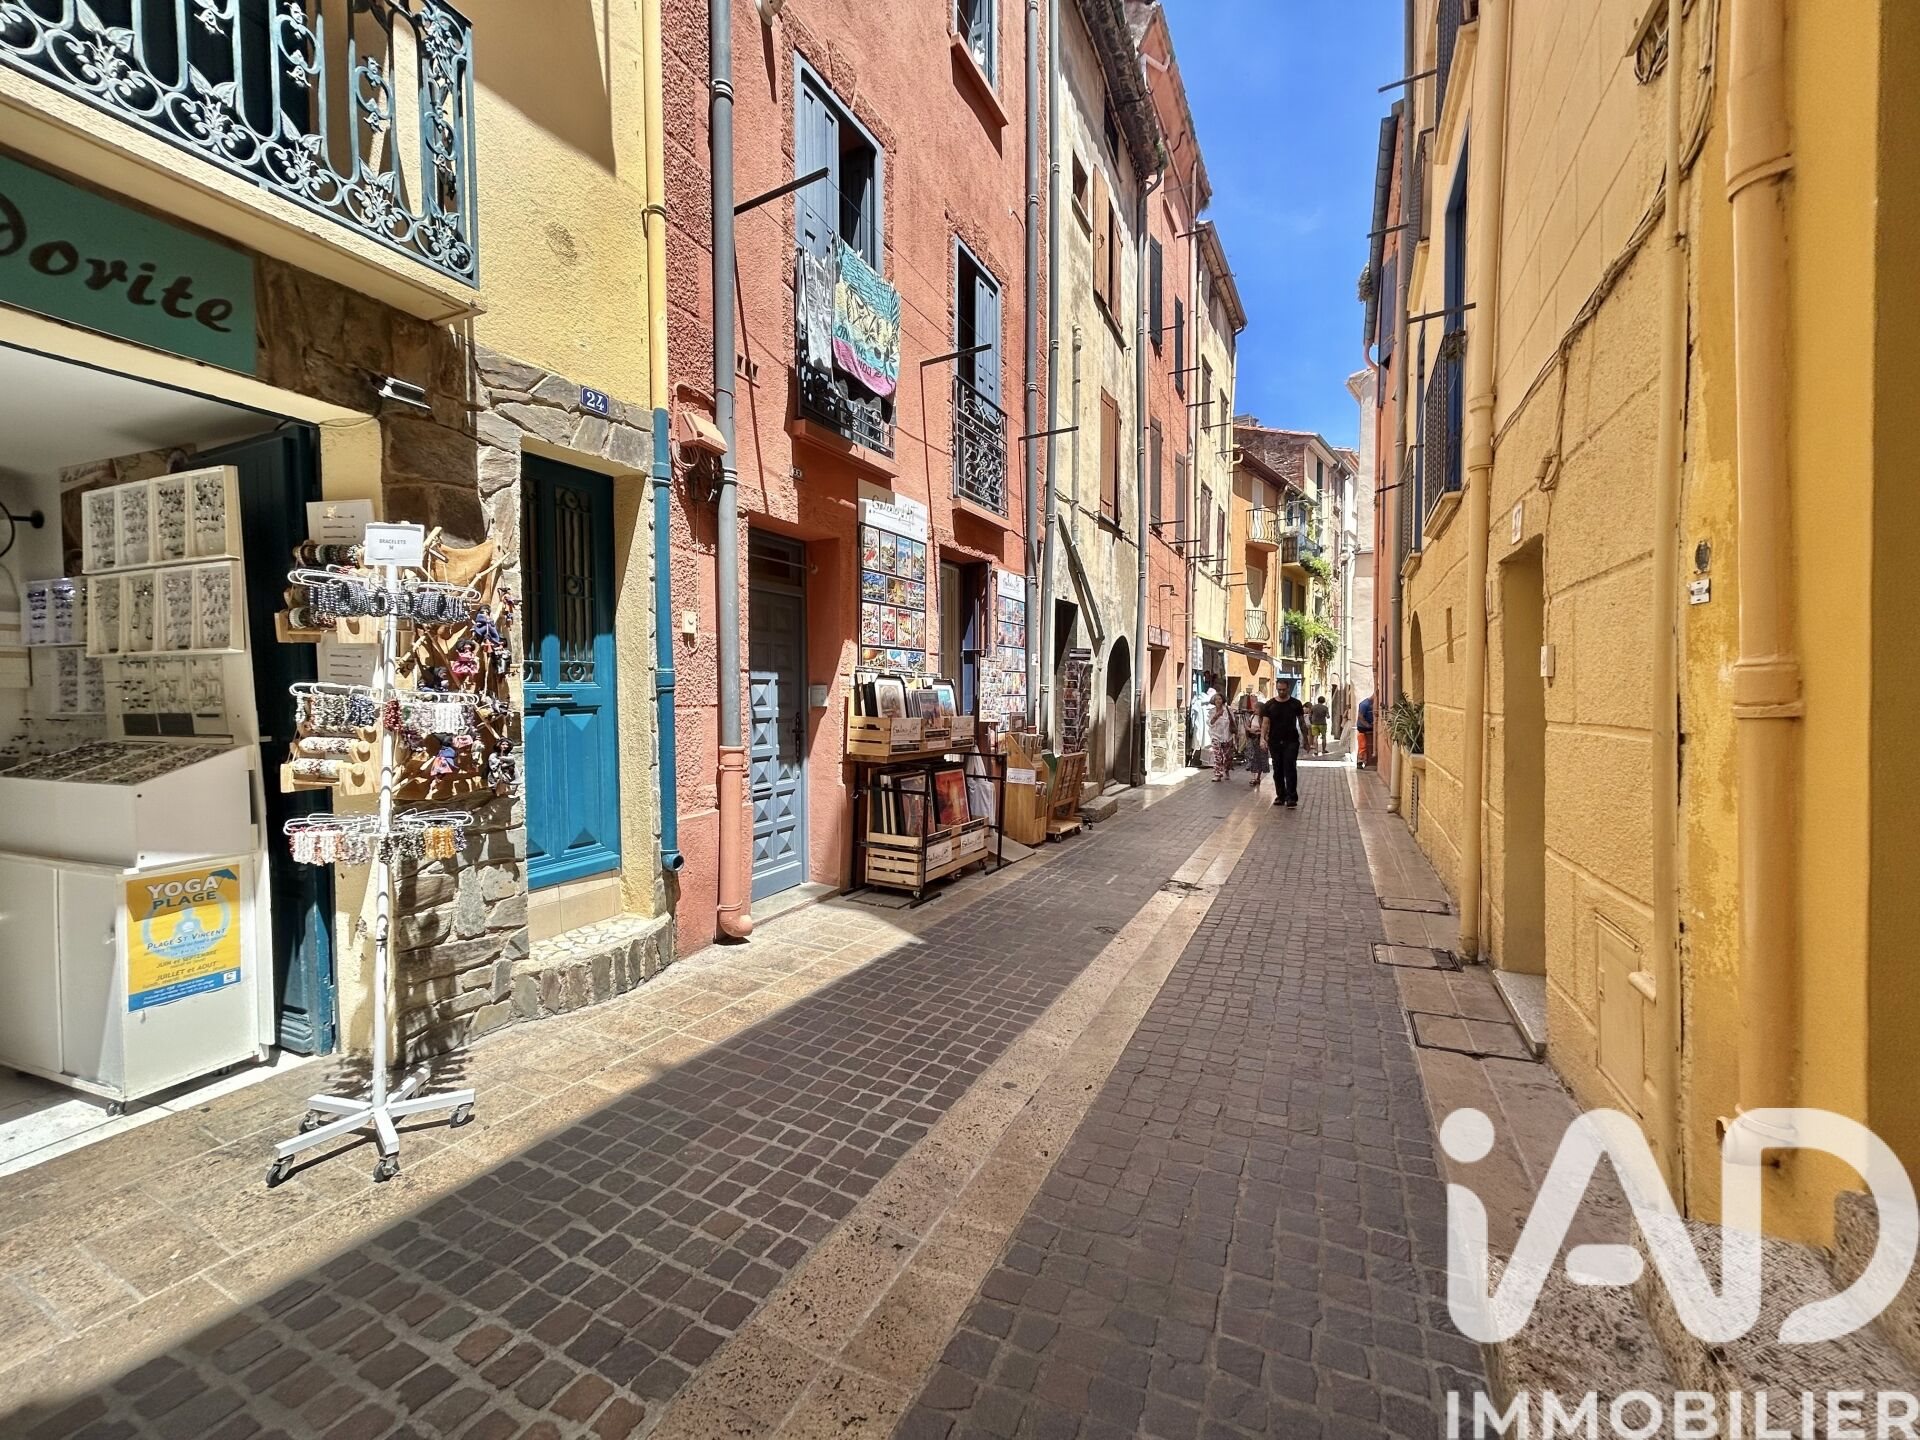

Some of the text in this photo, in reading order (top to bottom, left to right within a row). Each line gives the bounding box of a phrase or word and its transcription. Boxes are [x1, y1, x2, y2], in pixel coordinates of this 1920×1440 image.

[586, 391, 605, 411] 24
[147, 875, 219, 899] YOGA
[153, 890, 217, 910] PLAGE
[156, 968, 185, 982] JUILLET
